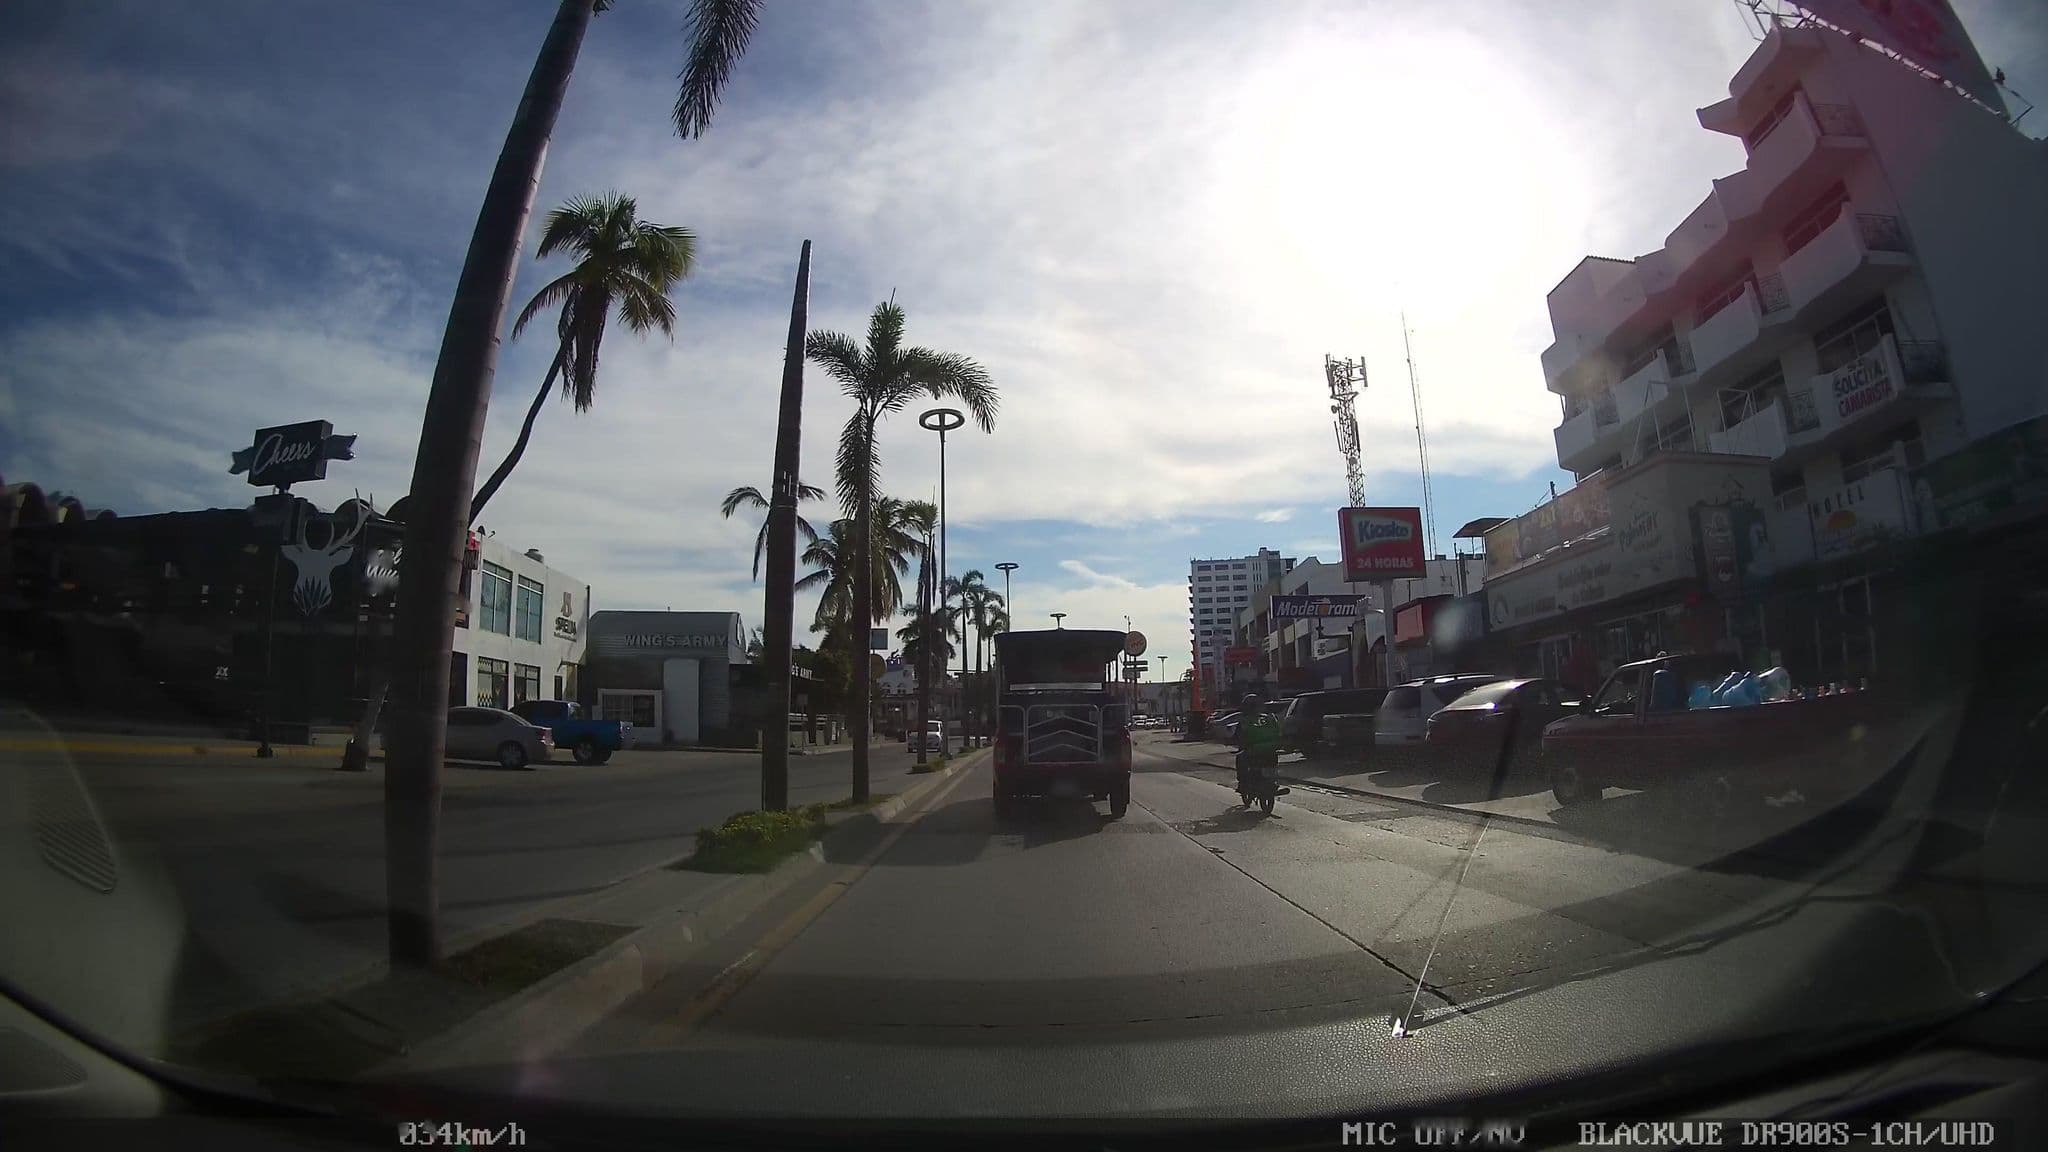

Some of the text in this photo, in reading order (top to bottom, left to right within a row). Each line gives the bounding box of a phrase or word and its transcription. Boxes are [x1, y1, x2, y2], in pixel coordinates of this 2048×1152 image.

[251, 431, 317, 476] Cheers
[1358, 519, 1409, 543] Kiosko
[1356, 555, 1414, 569] 24 HORAS
[680, 632, 728, 648] ARMY
